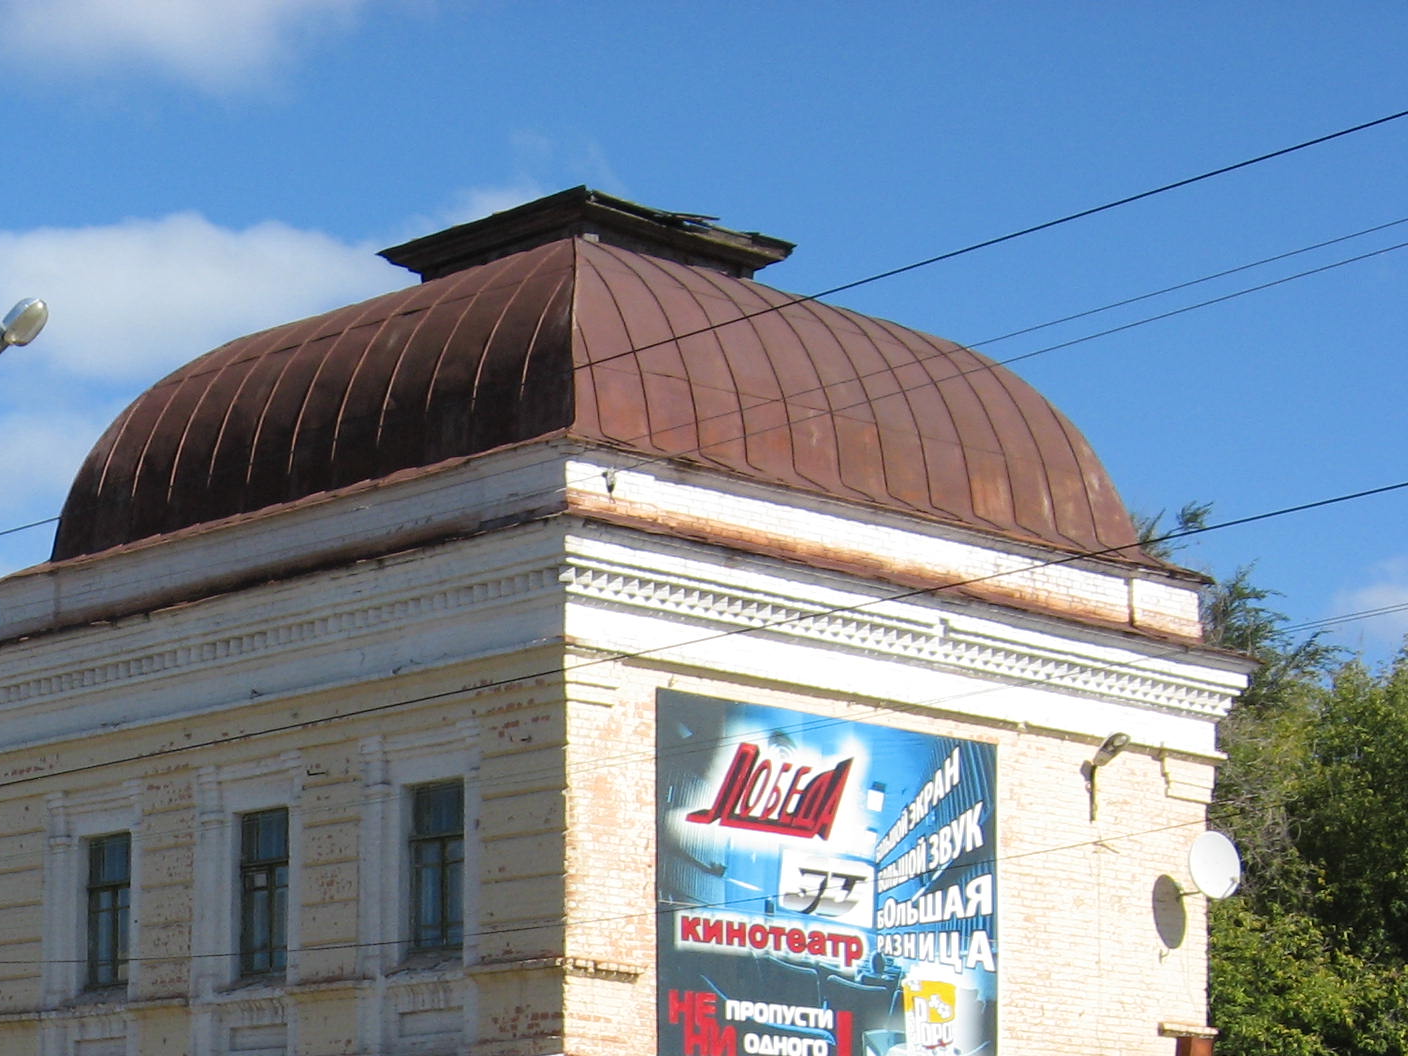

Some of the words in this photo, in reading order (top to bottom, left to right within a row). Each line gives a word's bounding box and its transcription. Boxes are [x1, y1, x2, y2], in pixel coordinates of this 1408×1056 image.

[685, 742, 854, 841] ПОБЕДА
[908, 747, 961, 830] ЭКРАН
[929, 802, 984, 870] ЗВУК
[877, 930, 996, 974] РАЗНИЦА
[725, 999, 834, 1029] ПРОПУСТИ
